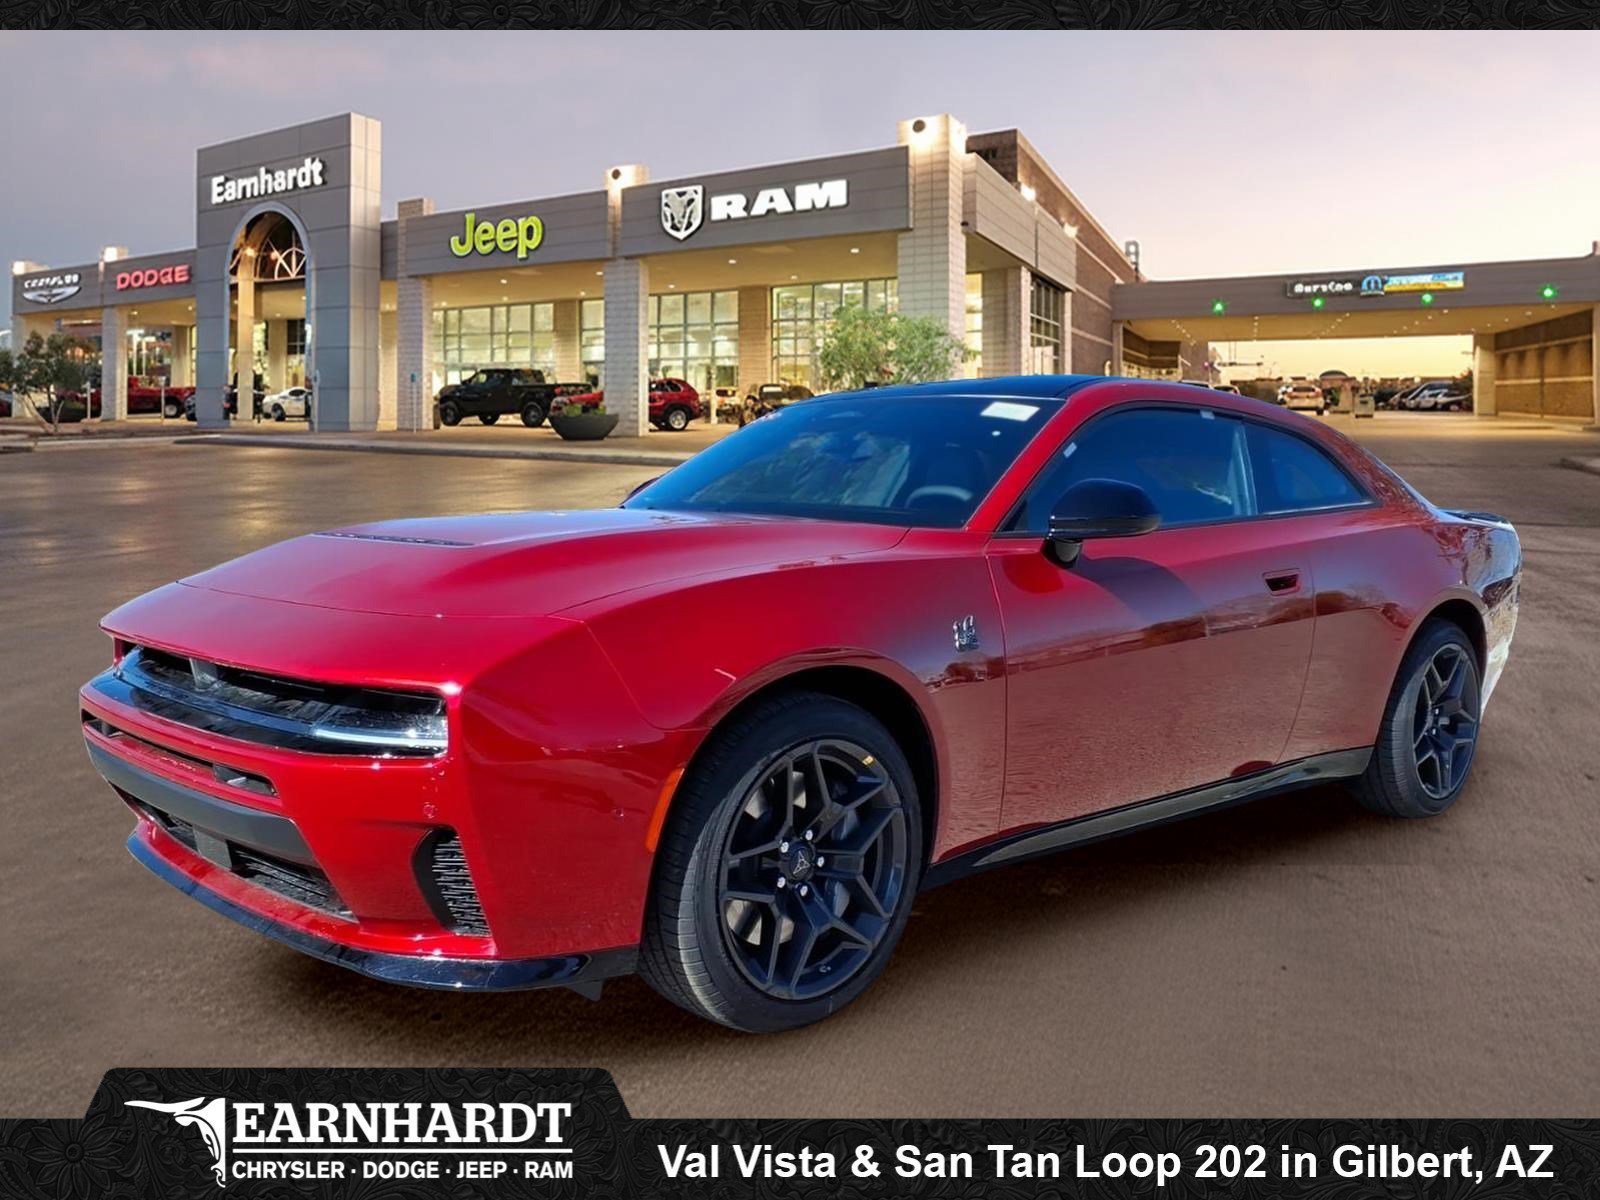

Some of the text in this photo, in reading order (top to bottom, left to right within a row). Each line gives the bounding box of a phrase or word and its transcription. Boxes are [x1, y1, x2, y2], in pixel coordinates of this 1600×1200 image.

[211, 157, 325, 205] Earnhardt
[710, 179, 849, 221] RAM
[450, 213, 543, 259] Jeep
[115, 264, 191, 291] DODGE
